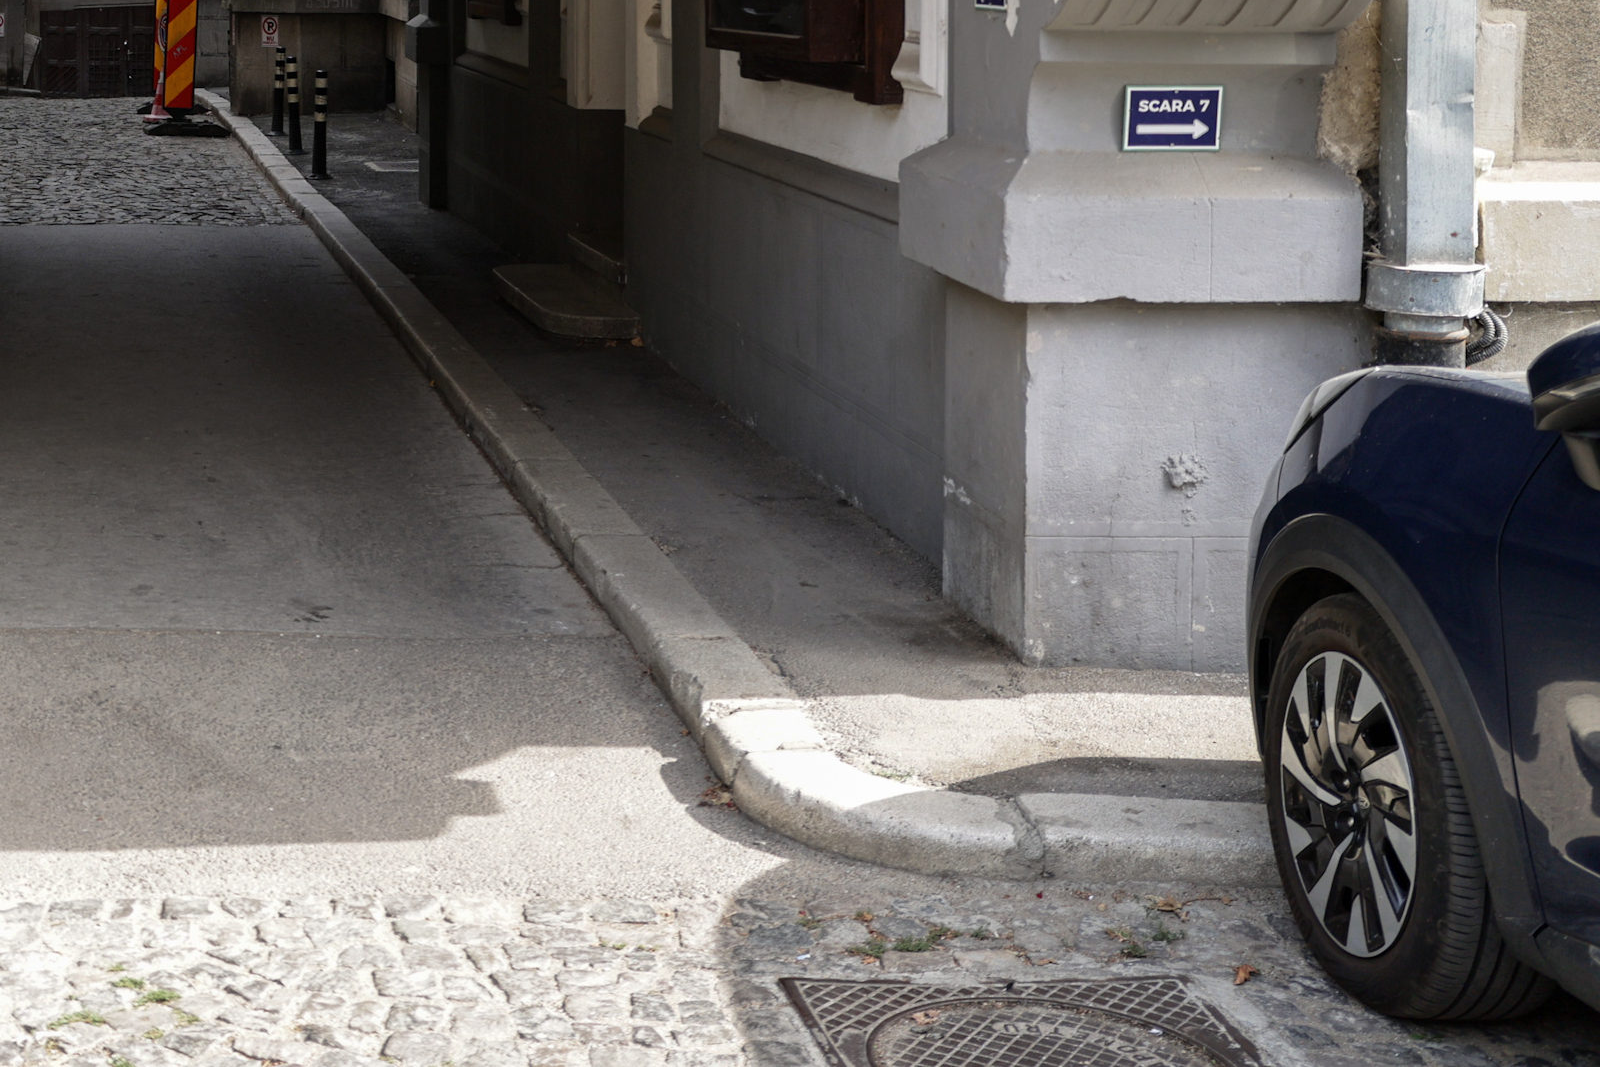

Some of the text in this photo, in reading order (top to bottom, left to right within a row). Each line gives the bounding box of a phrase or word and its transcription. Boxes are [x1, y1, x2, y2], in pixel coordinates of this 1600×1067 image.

[172, 44, 188, 59] APL
[1138, 99, 1210, 113] SCARA 7
